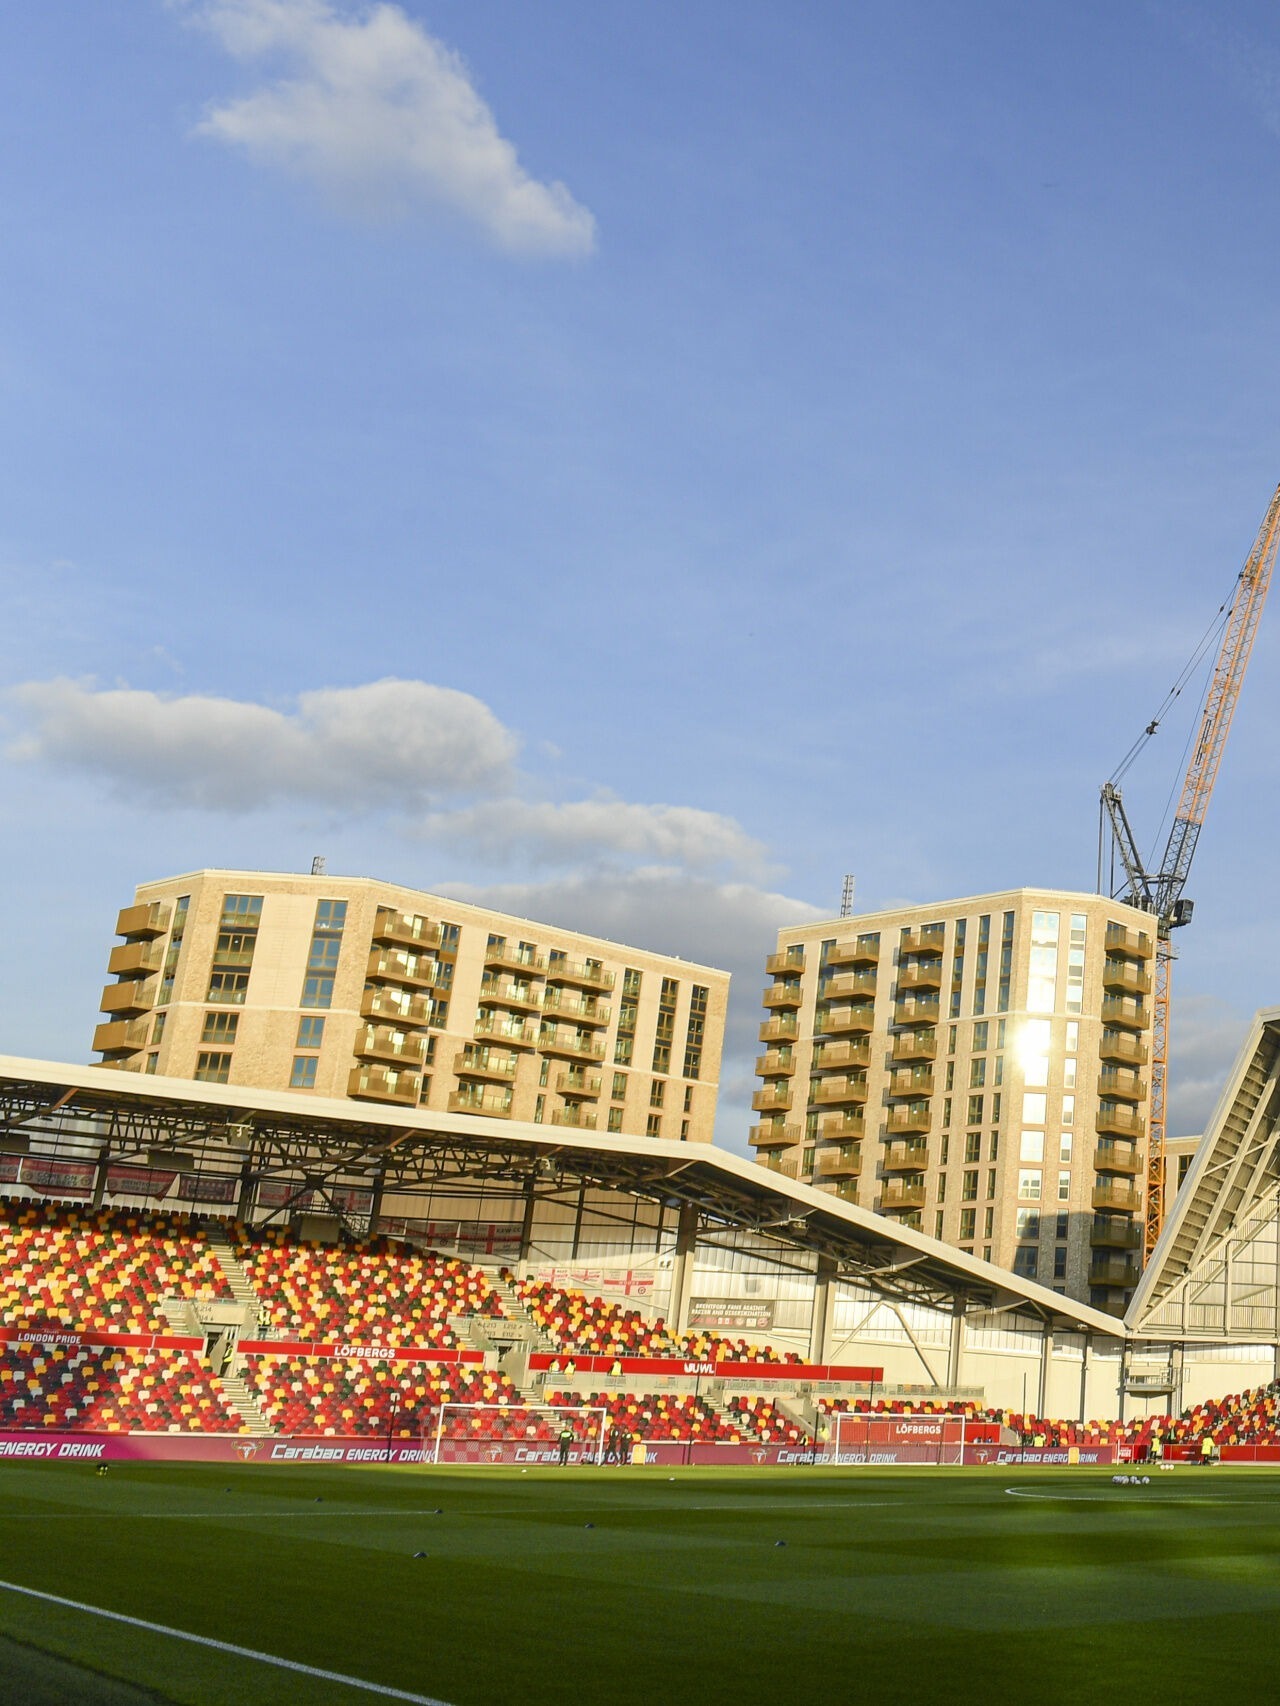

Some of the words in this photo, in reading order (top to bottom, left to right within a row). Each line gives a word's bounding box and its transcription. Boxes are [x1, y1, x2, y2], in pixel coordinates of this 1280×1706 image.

[18, 1332, 55, 1343] LONDON
[55, 1334, 82, 1344] PRIDE
[333, 1344, 396, 1359] LÖFBERGS
[895, 1423, 941, 1434] LÖFBERGS
[0, 1442, 58, 1457] ENERGY
[58, 1443, 106, 1457] DRINK
[271, 1444, 345, 1460] Carabao
[346, 1448, 398, 1462] ENERGY
[514, 1447, 578, 1462] Carabo
[776, 1450, 830, 1463] Carabao
[869, 1453, 898, 1463] DRINK
[997, 1451, 1041, 1463] Carabao
[1042, 1453, 1069, 1463] ENERG
[1078, 1453, 1098, 1463] RINK
